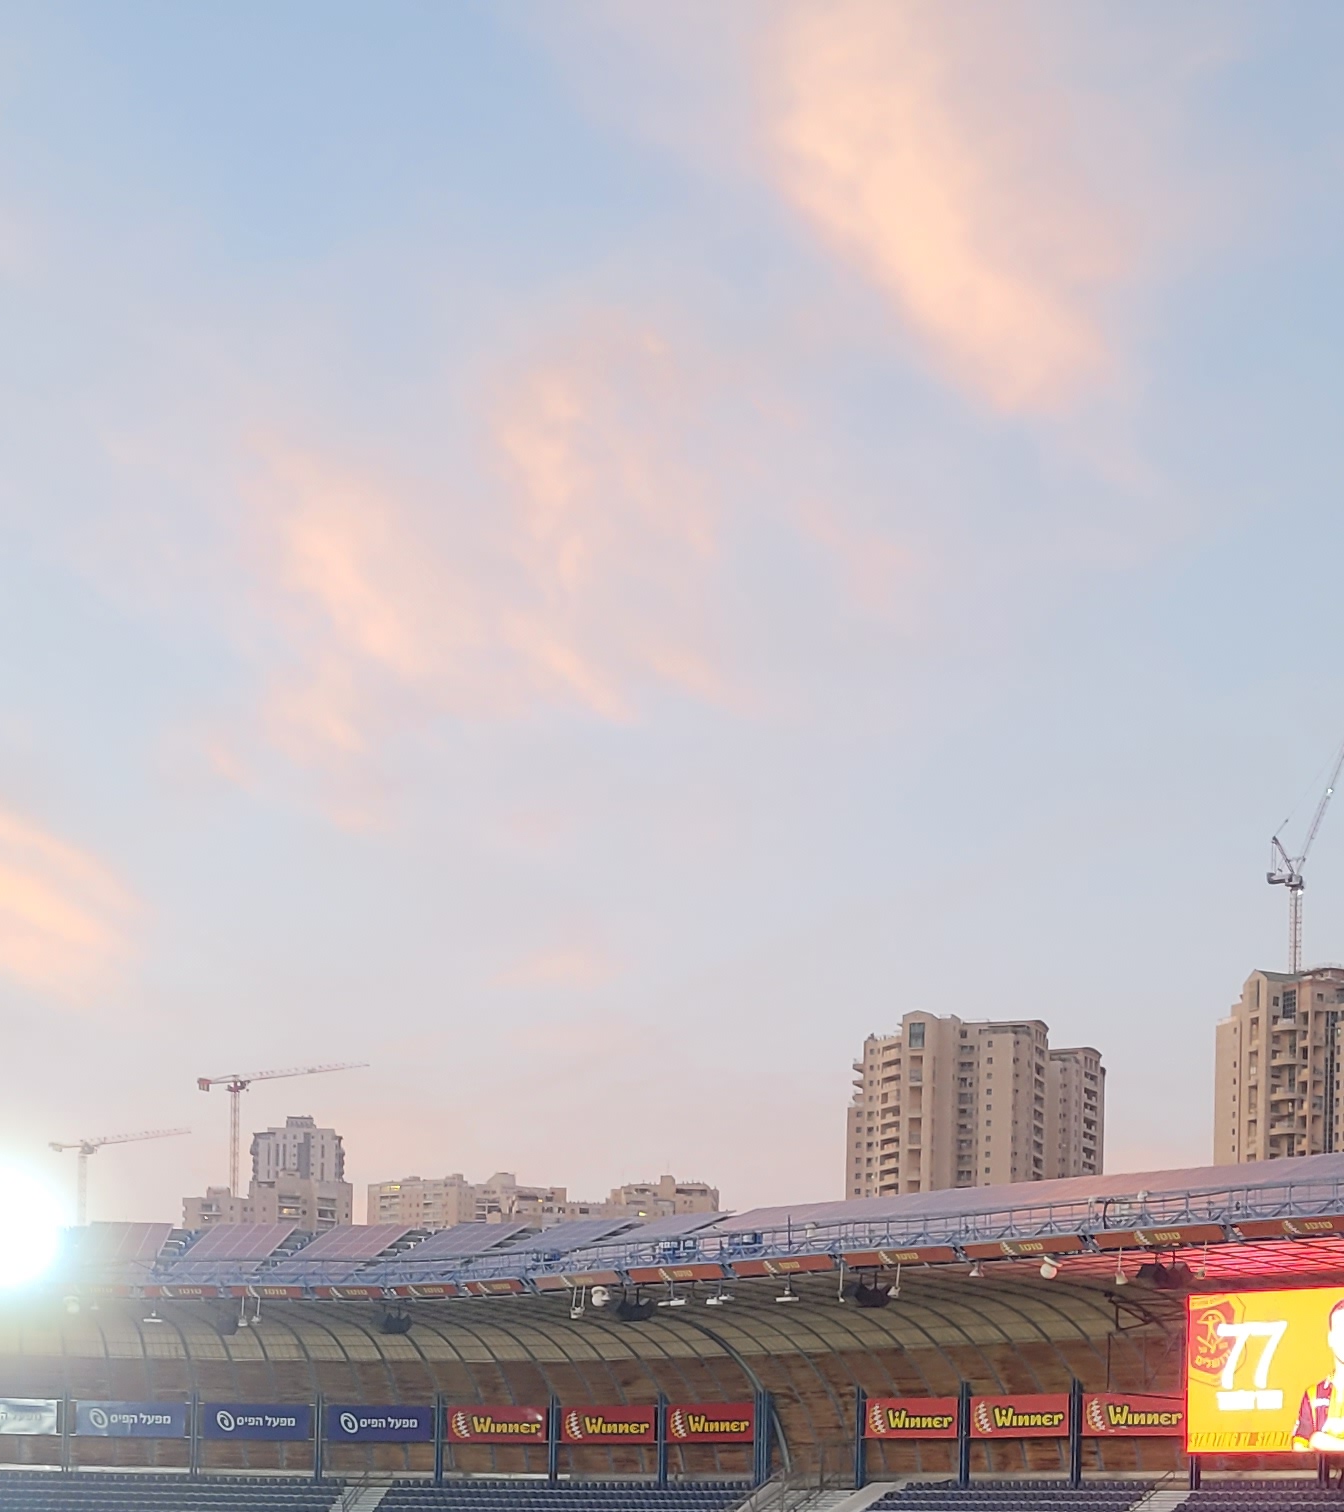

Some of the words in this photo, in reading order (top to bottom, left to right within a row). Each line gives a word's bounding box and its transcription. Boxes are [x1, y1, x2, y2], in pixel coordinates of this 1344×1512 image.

[1216, 1320, 1288, 1389] 77
[110, 1413, 138, 1424] הפיס
[139, 1412, 171, 1424] מפעל
[236, 1416, 263, 1427] הפיס
[265, 1415, 296, 1427] מפעל
[359, 1417, 386, 1428] הפיס
[387, 1416, 418, 1429] מפעל
